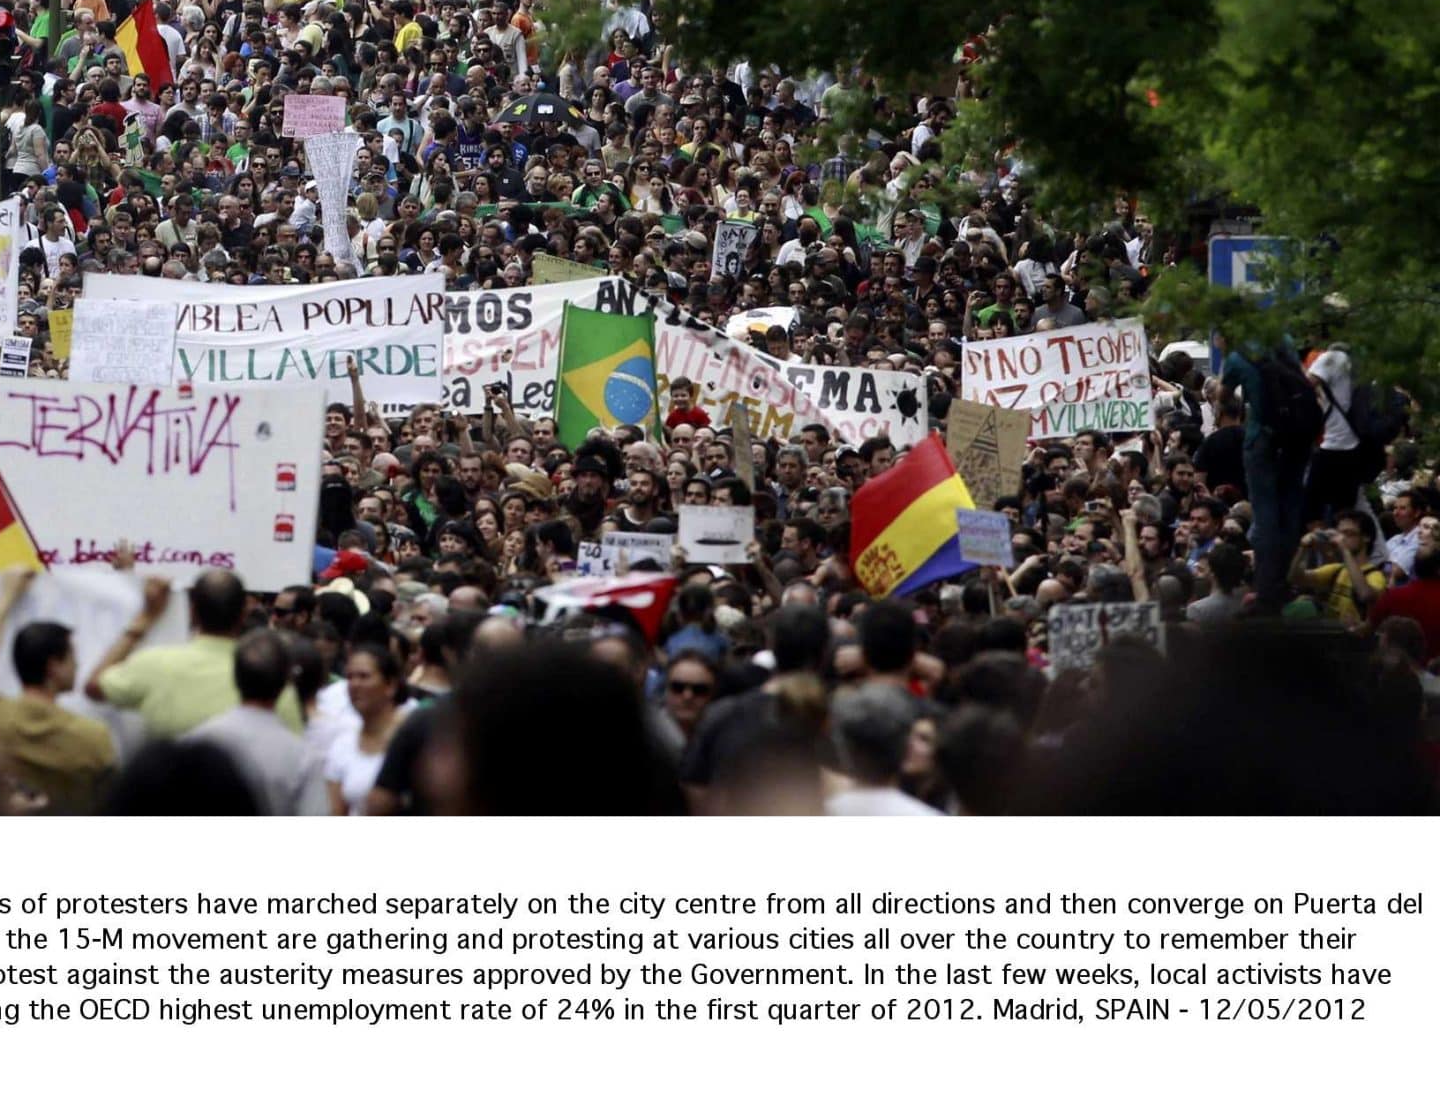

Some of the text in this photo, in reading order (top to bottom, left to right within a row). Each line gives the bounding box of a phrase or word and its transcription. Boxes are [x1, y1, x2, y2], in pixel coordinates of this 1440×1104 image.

[302, 292, 446, 328] POPULAR
[177, 342, 438, 383] VILLAVERDE
[1047, 399, 1150, 433] VILLAVERDE
